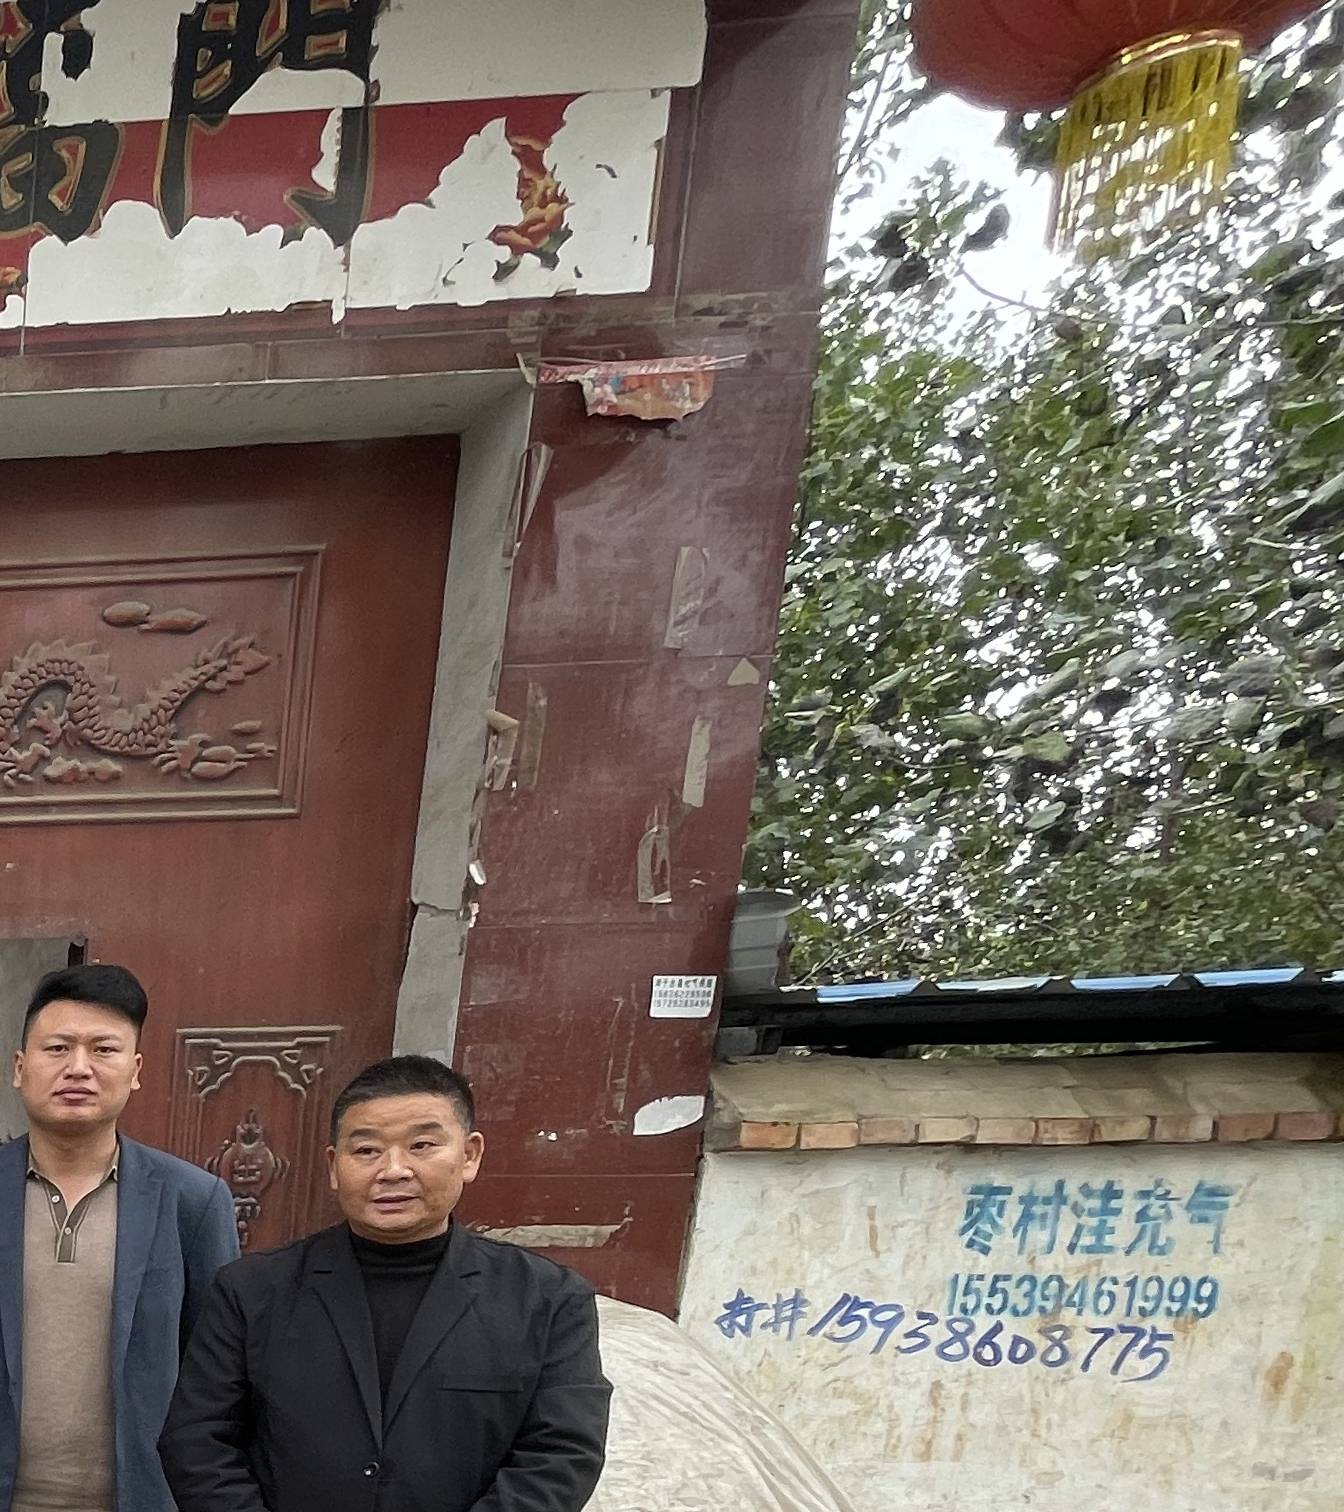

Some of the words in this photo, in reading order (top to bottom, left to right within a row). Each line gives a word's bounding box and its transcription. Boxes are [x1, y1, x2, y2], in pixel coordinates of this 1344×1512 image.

[956, 1178, 1238, 1256] 枣村洼充气
[947, 1272, 1220, 1320] 15539461999
[806, 1292, 1176, 1383] 15938608775
